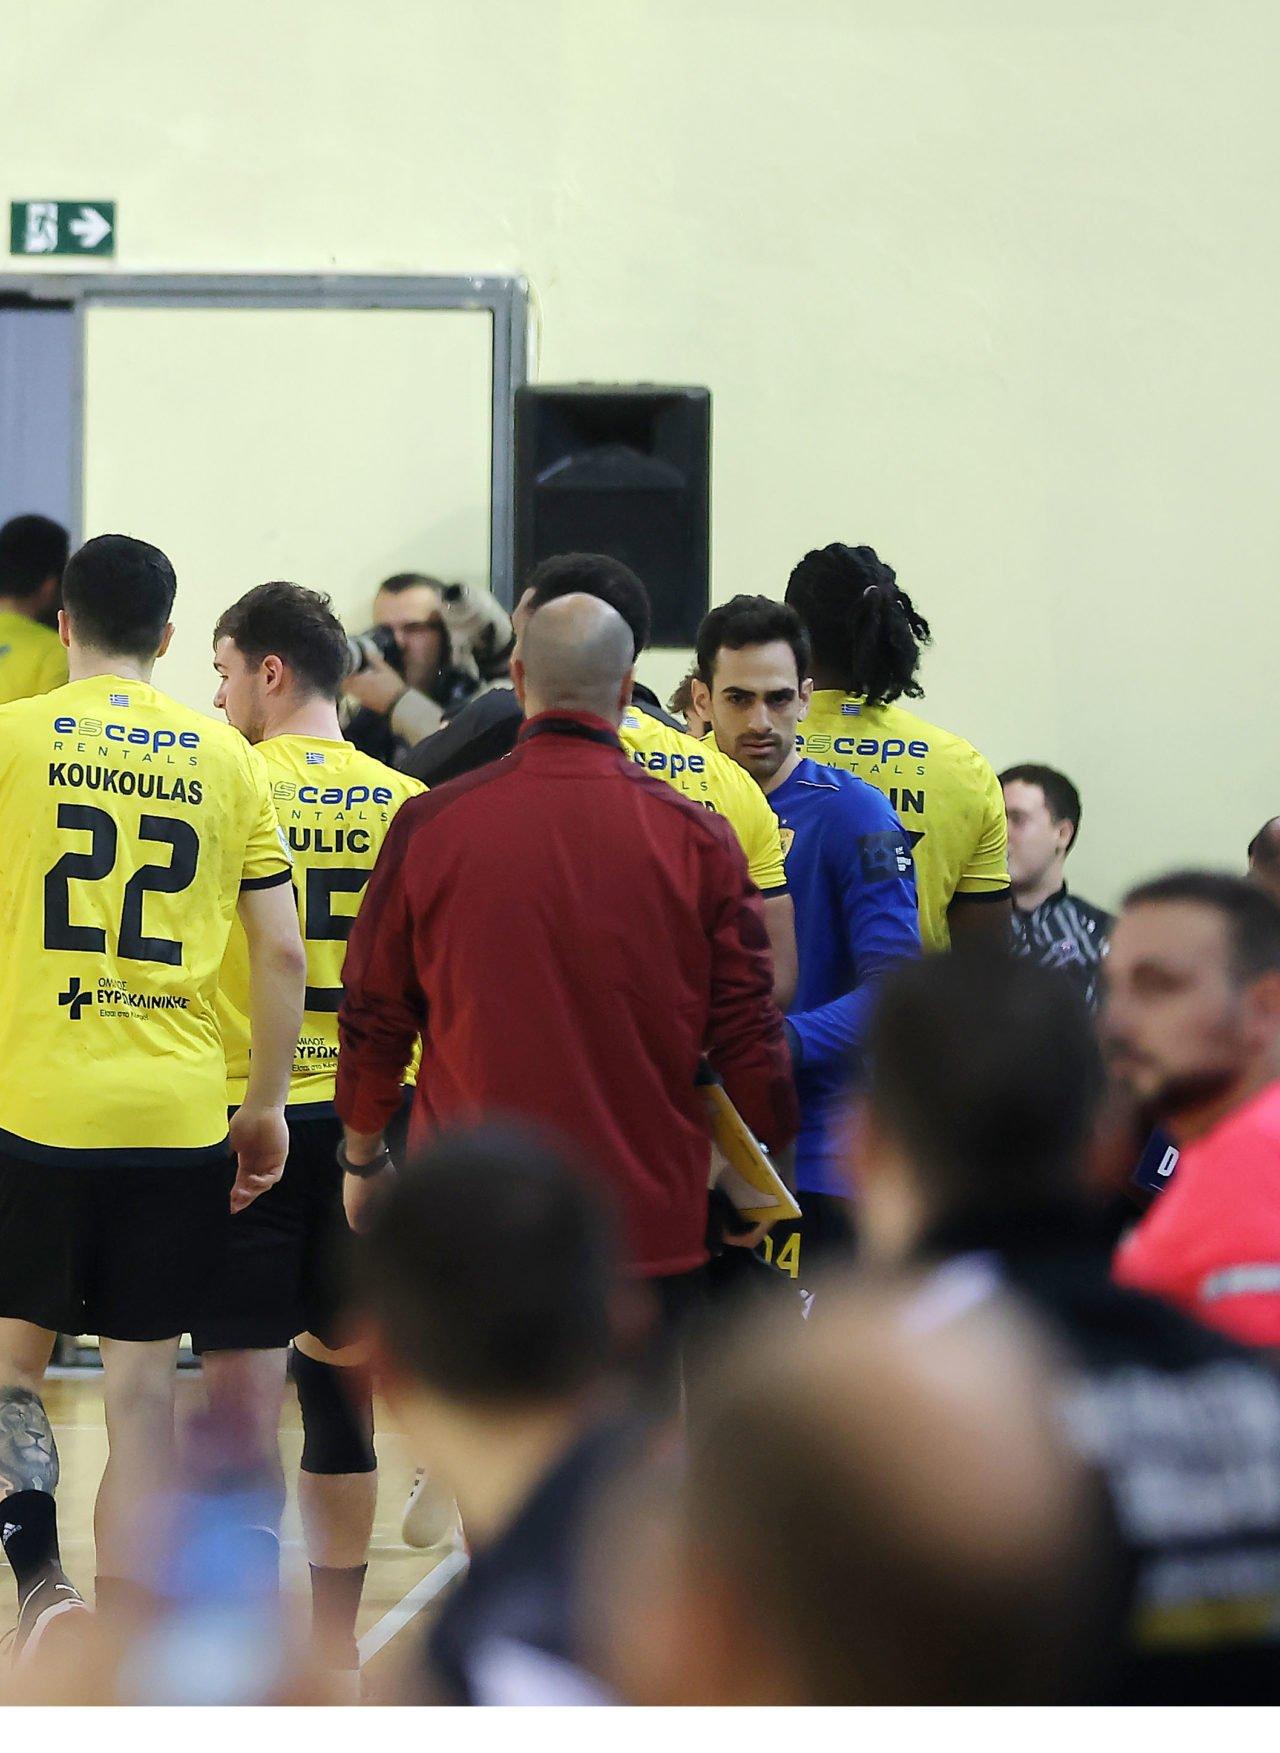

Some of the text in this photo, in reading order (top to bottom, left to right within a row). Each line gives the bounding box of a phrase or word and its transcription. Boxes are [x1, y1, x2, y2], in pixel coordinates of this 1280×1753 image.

[54, 717, 200, 753] escape
[54, 741, 198, 766] RENTALS
[48, 762, 203, 805] KOUKOULAS
[270, 781, 393, 810] scape
[44, 803, 199, 966] 22
